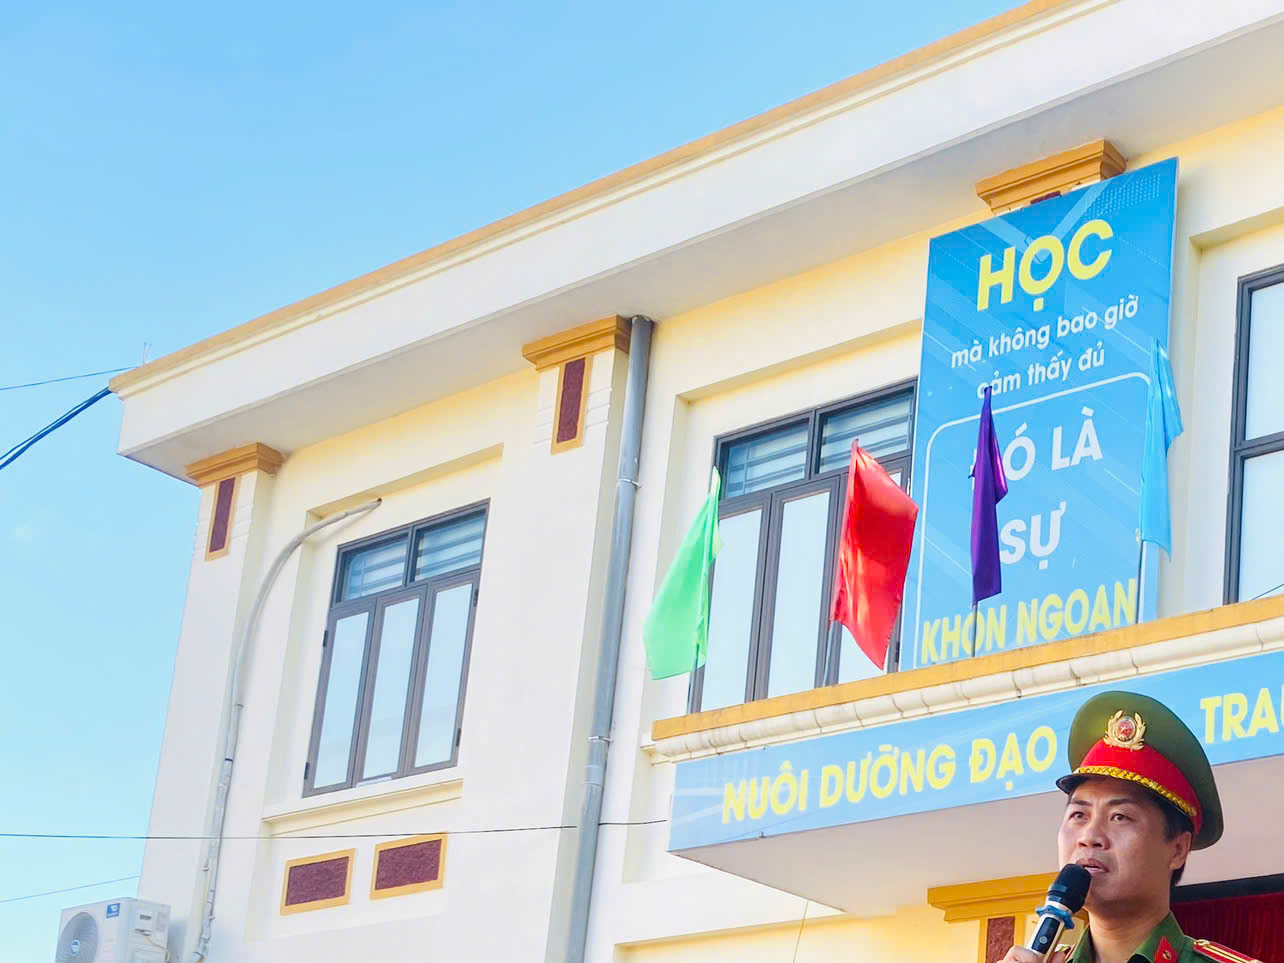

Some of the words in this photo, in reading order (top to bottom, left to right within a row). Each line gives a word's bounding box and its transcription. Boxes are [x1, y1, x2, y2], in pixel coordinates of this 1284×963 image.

[976, 219, 1113, 312] HỌC
[951, 340, 982, 369] mà
[988, 324, 1050, 358] không
[1057, 311, 1098, 338] bao
[1104, 294, 1139, 330] giờ
[977, 371, 1021, 399] cảm
[1027, 350, 1072, 386] thấy
[1078, 341, 1105, 371] đủ
[970, 422, 1036, 492] Ó
[1051, 406, 1103, 471] LÀ
[999, 500, 1067, 570] SỰ
[1017, 578, 1137, 646] NGOAN
[722, 760, 809, 824] NUÔI
[819, 744, 956, 808] DƯỠNG
[968, 725, 1058, 791] ĐẠO
